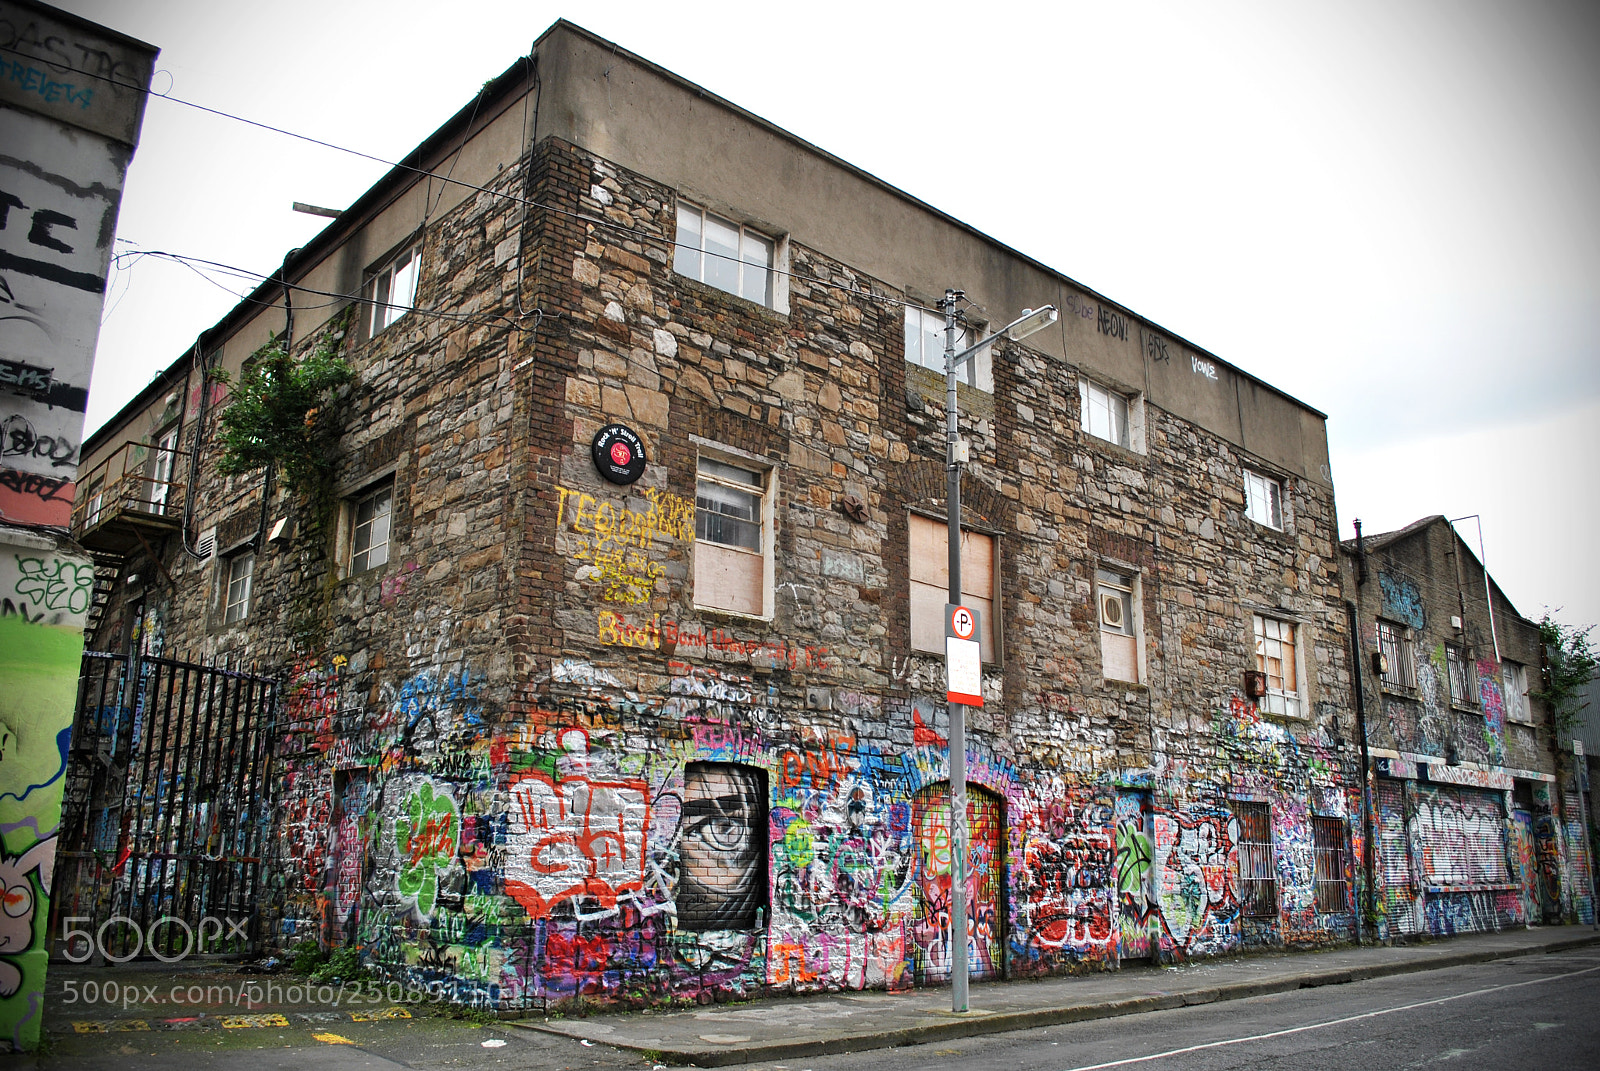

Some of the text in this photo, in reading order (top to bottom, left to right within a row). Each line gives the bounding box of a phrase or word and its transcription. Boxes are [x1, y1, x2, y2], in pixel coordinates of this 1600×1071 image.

[597, 432, 611, 448] Rock
[620, 428, 637, 443] Stroll
[634, 441, 644, 459] Trail
[666, 620, 707, 647] Bank
